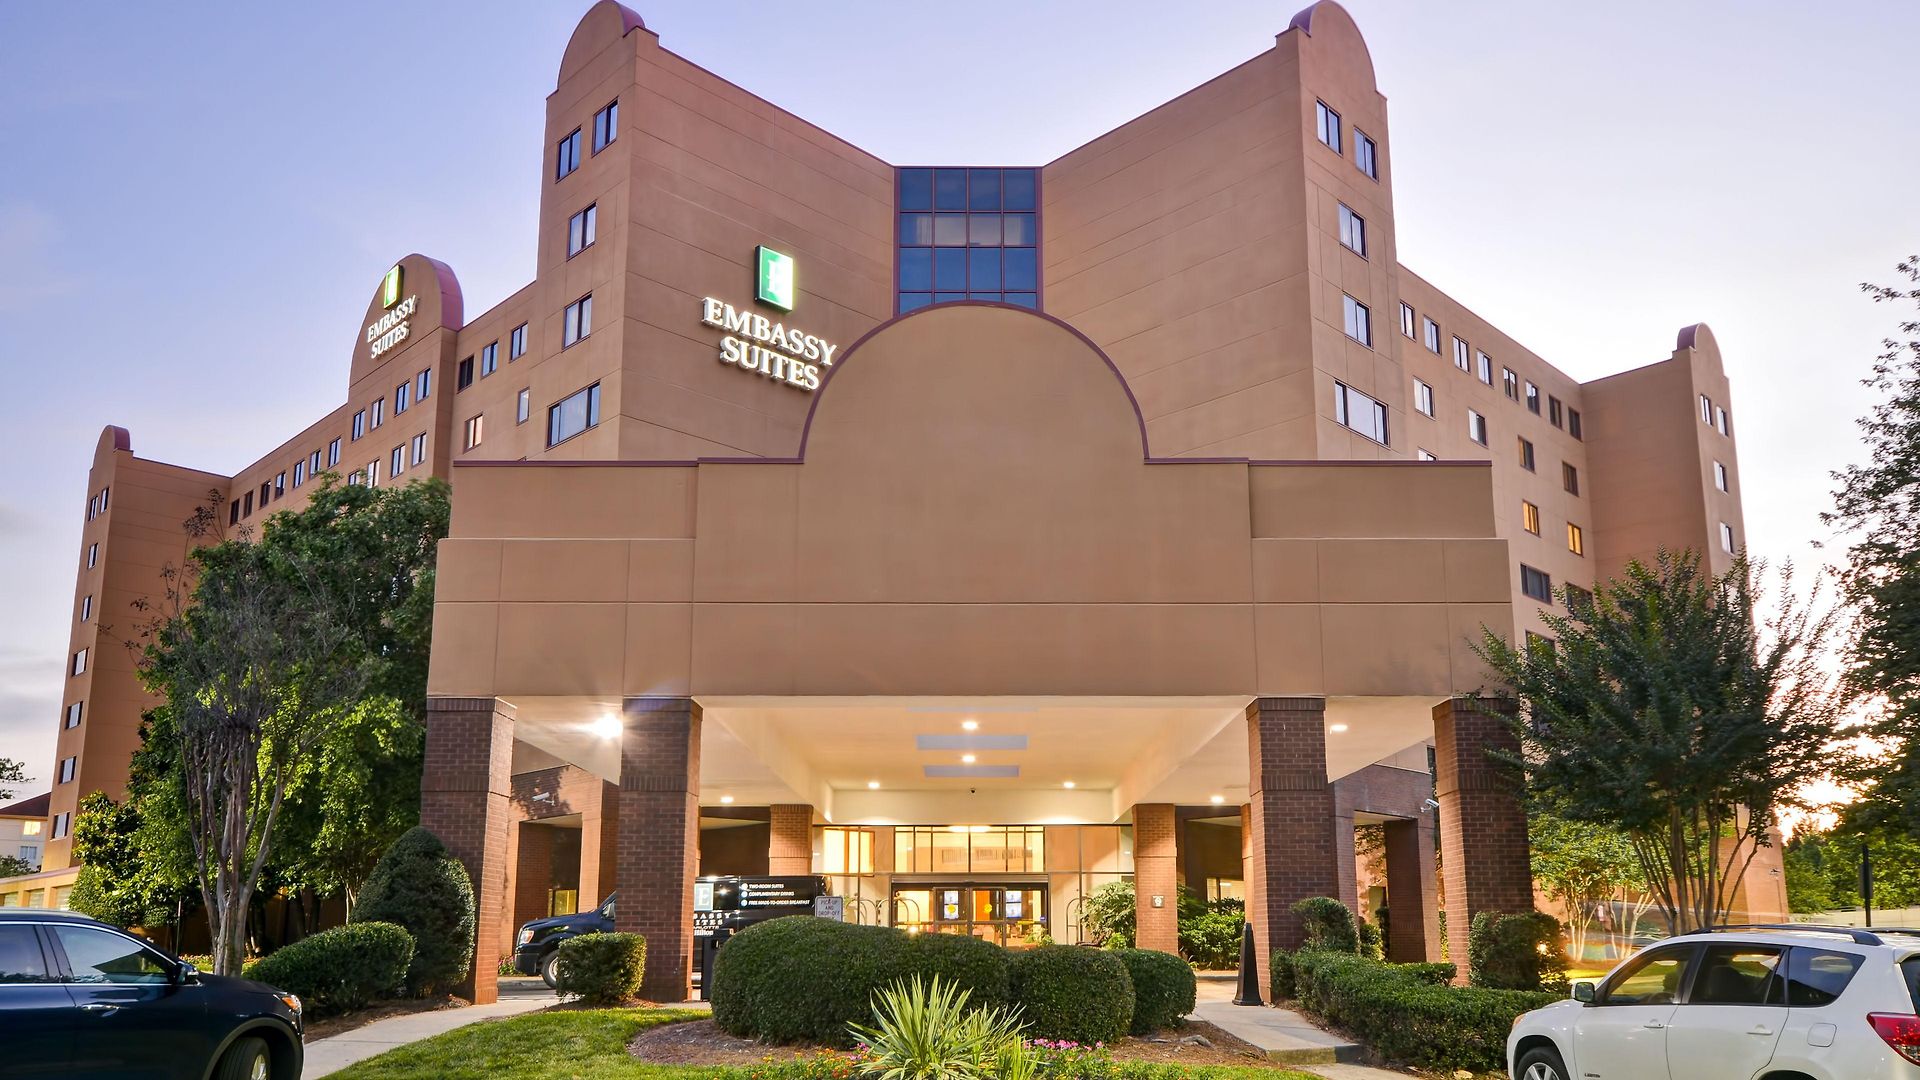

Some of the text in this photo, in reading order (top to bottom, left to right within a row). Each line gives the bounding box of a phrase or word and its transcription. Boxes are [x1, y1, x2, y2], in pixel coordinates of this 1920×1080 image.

[367, 295, 416, 343] EMBASSY
[372, 321, 410, 359] SUITES
[702, 297, 837, 366] EMBASSY
[720, 336, 819, 390] SUITES
